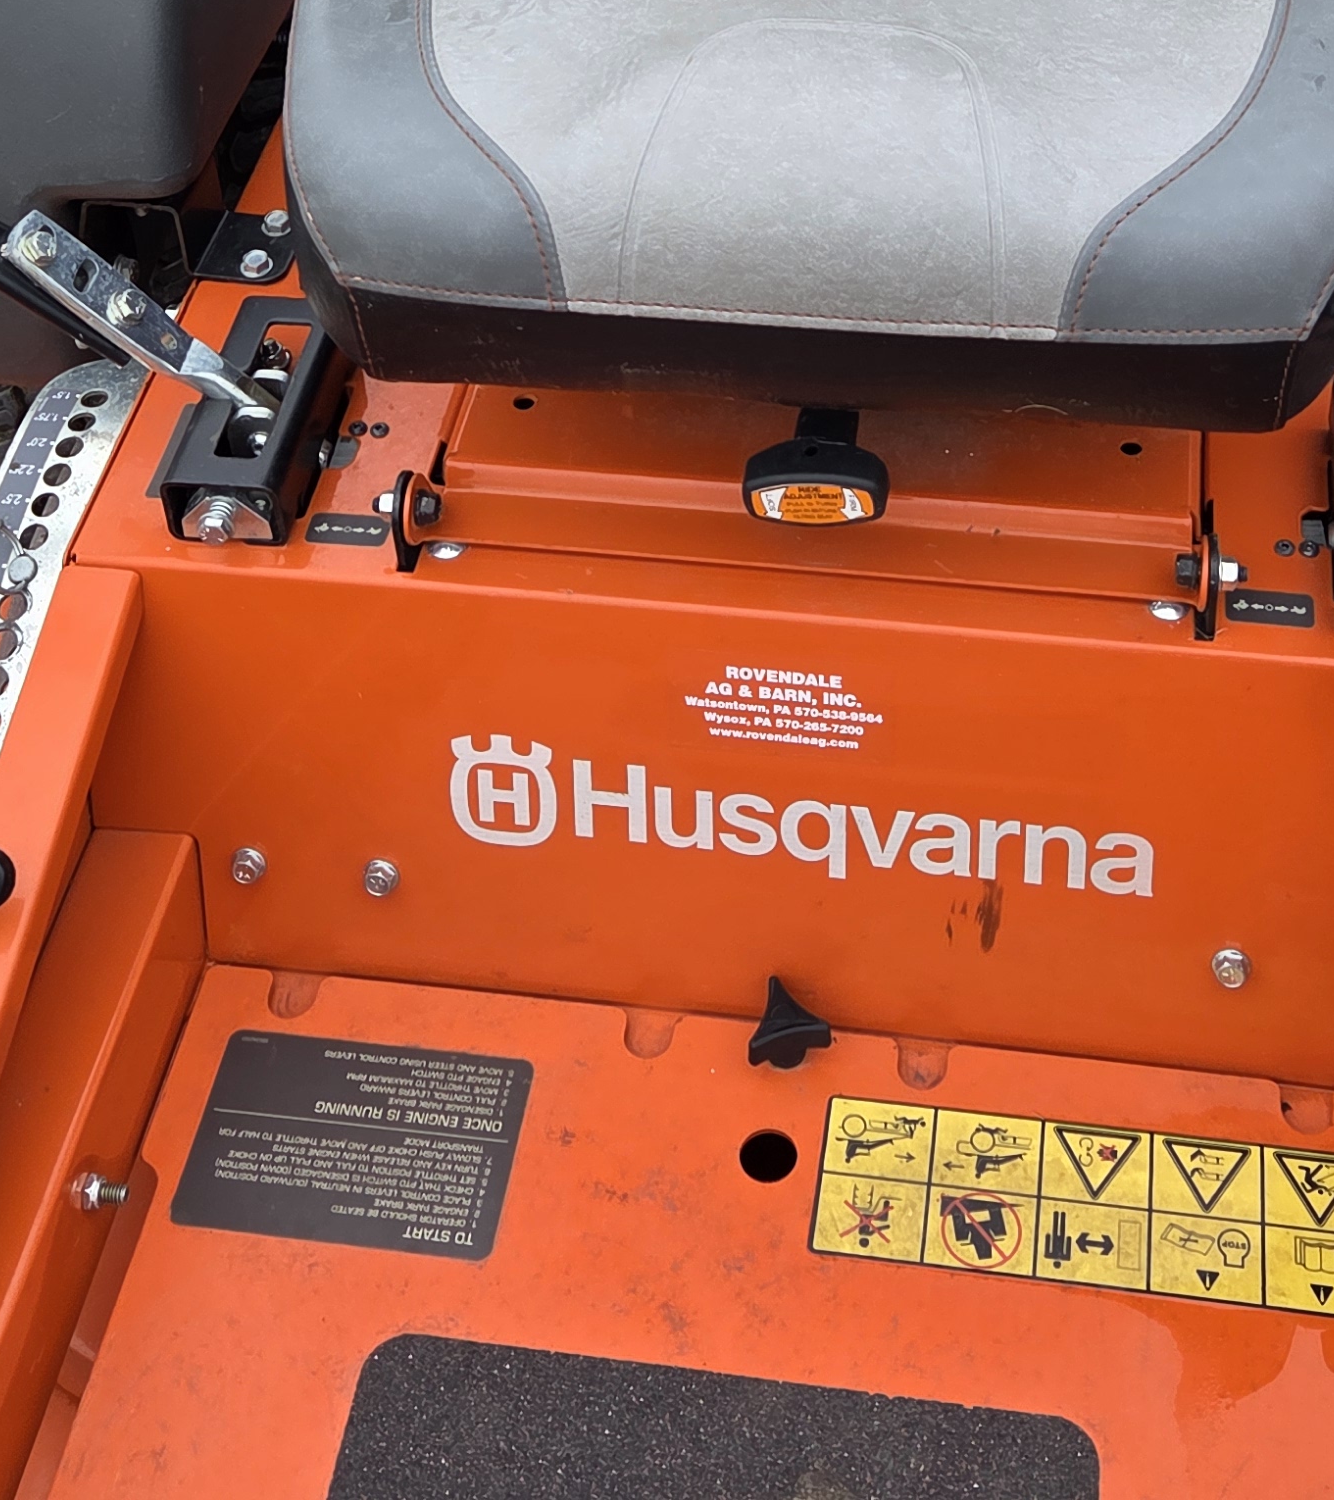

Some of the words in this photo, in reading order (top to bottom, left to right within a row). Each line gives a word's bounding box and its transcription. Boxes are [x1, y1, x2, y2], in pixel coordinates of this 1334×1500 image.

[725, 665, 842, 688] ROVENDALE
[704, 681, 732, 695] AG
[737, 684, 752, 697] &
[758, 686, 817, 705] BARN,
[822, 691, 861, 708] INC.
[684, 695, 769, 714] Watsontown,
[773, 704, 791, 715] PA
[703, 711, 751, 726] Wysox,
[753, 716, 772, 727] PA
[775, 718, 863, 735] 570-265-7200
[709, 727, 858, 748] www.rovendaleag.com
[573, 760, 1153, 897] Husqvarna
[314, 1100, 383, 1119] RUNNING
[386, 1108, 400, 1121] IS
[403, 1110, 458, 1127] ENGINE
[461, 1116, 502, 1132] ONCE
[401, 1225, 451, 1242] START
[454, 1231, 473, 1245] TO
[1221, 1239, 1247, 1250] STOP
